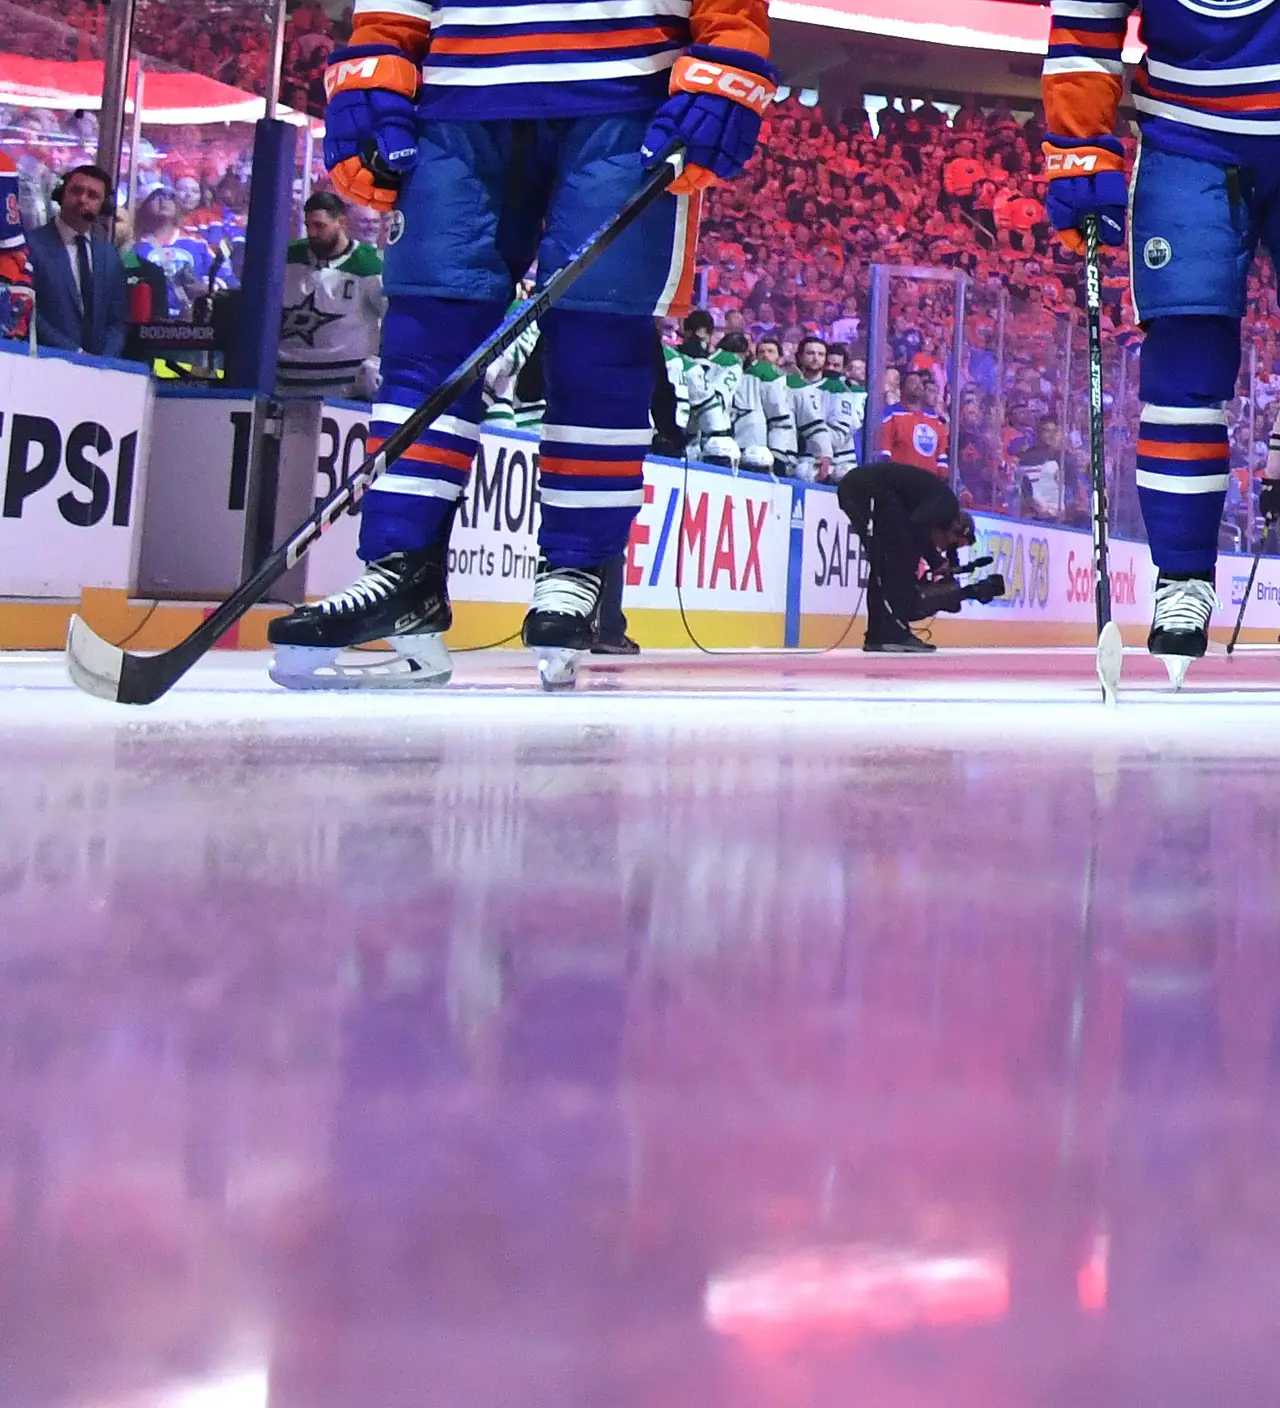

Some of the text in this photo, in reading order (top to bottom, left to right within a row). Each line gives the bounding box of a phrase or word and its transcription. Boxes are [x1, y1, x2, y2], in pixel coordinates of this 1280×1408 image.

[684, 62, 774, 110] CCM
[342, 279, 355, 300] C
[1086, 264, 1100, 309] CCM
[0, 412, 139, 527] PSI
[447, 542, 539, 579] ports Drin
[625, 483, 769, 593] E/MAX
